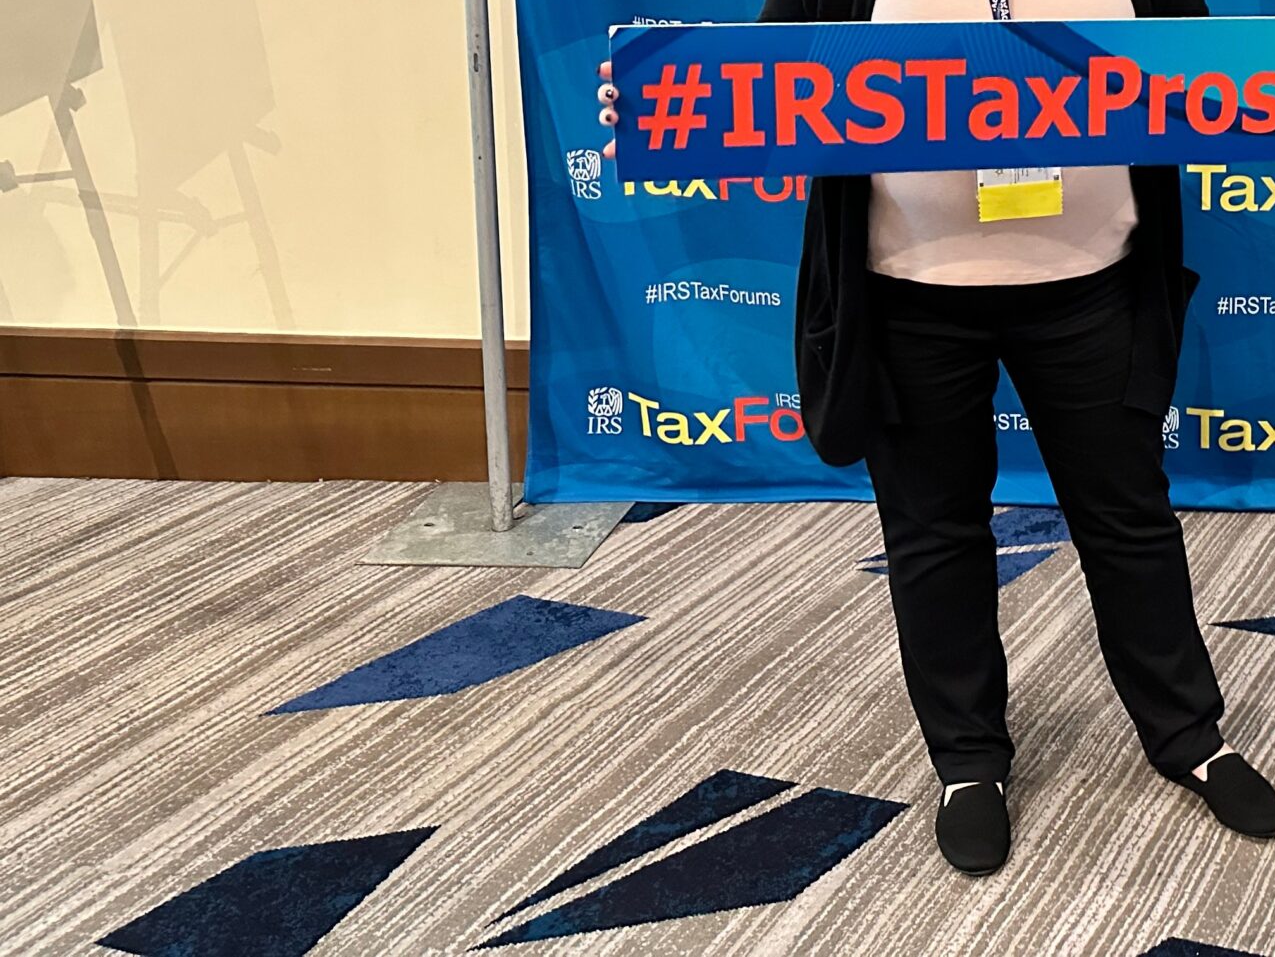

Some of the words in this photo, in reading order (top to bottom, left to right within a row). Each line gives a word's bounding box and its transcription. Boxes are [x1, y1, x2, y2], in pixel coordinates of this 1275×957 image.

[570, 178, 602, 200] IRS
[645, 281, 781, 306] #IRSTaxForums
[587, 414, 623, 435] IRS
[629, 393, 806, 445] TaxFo
